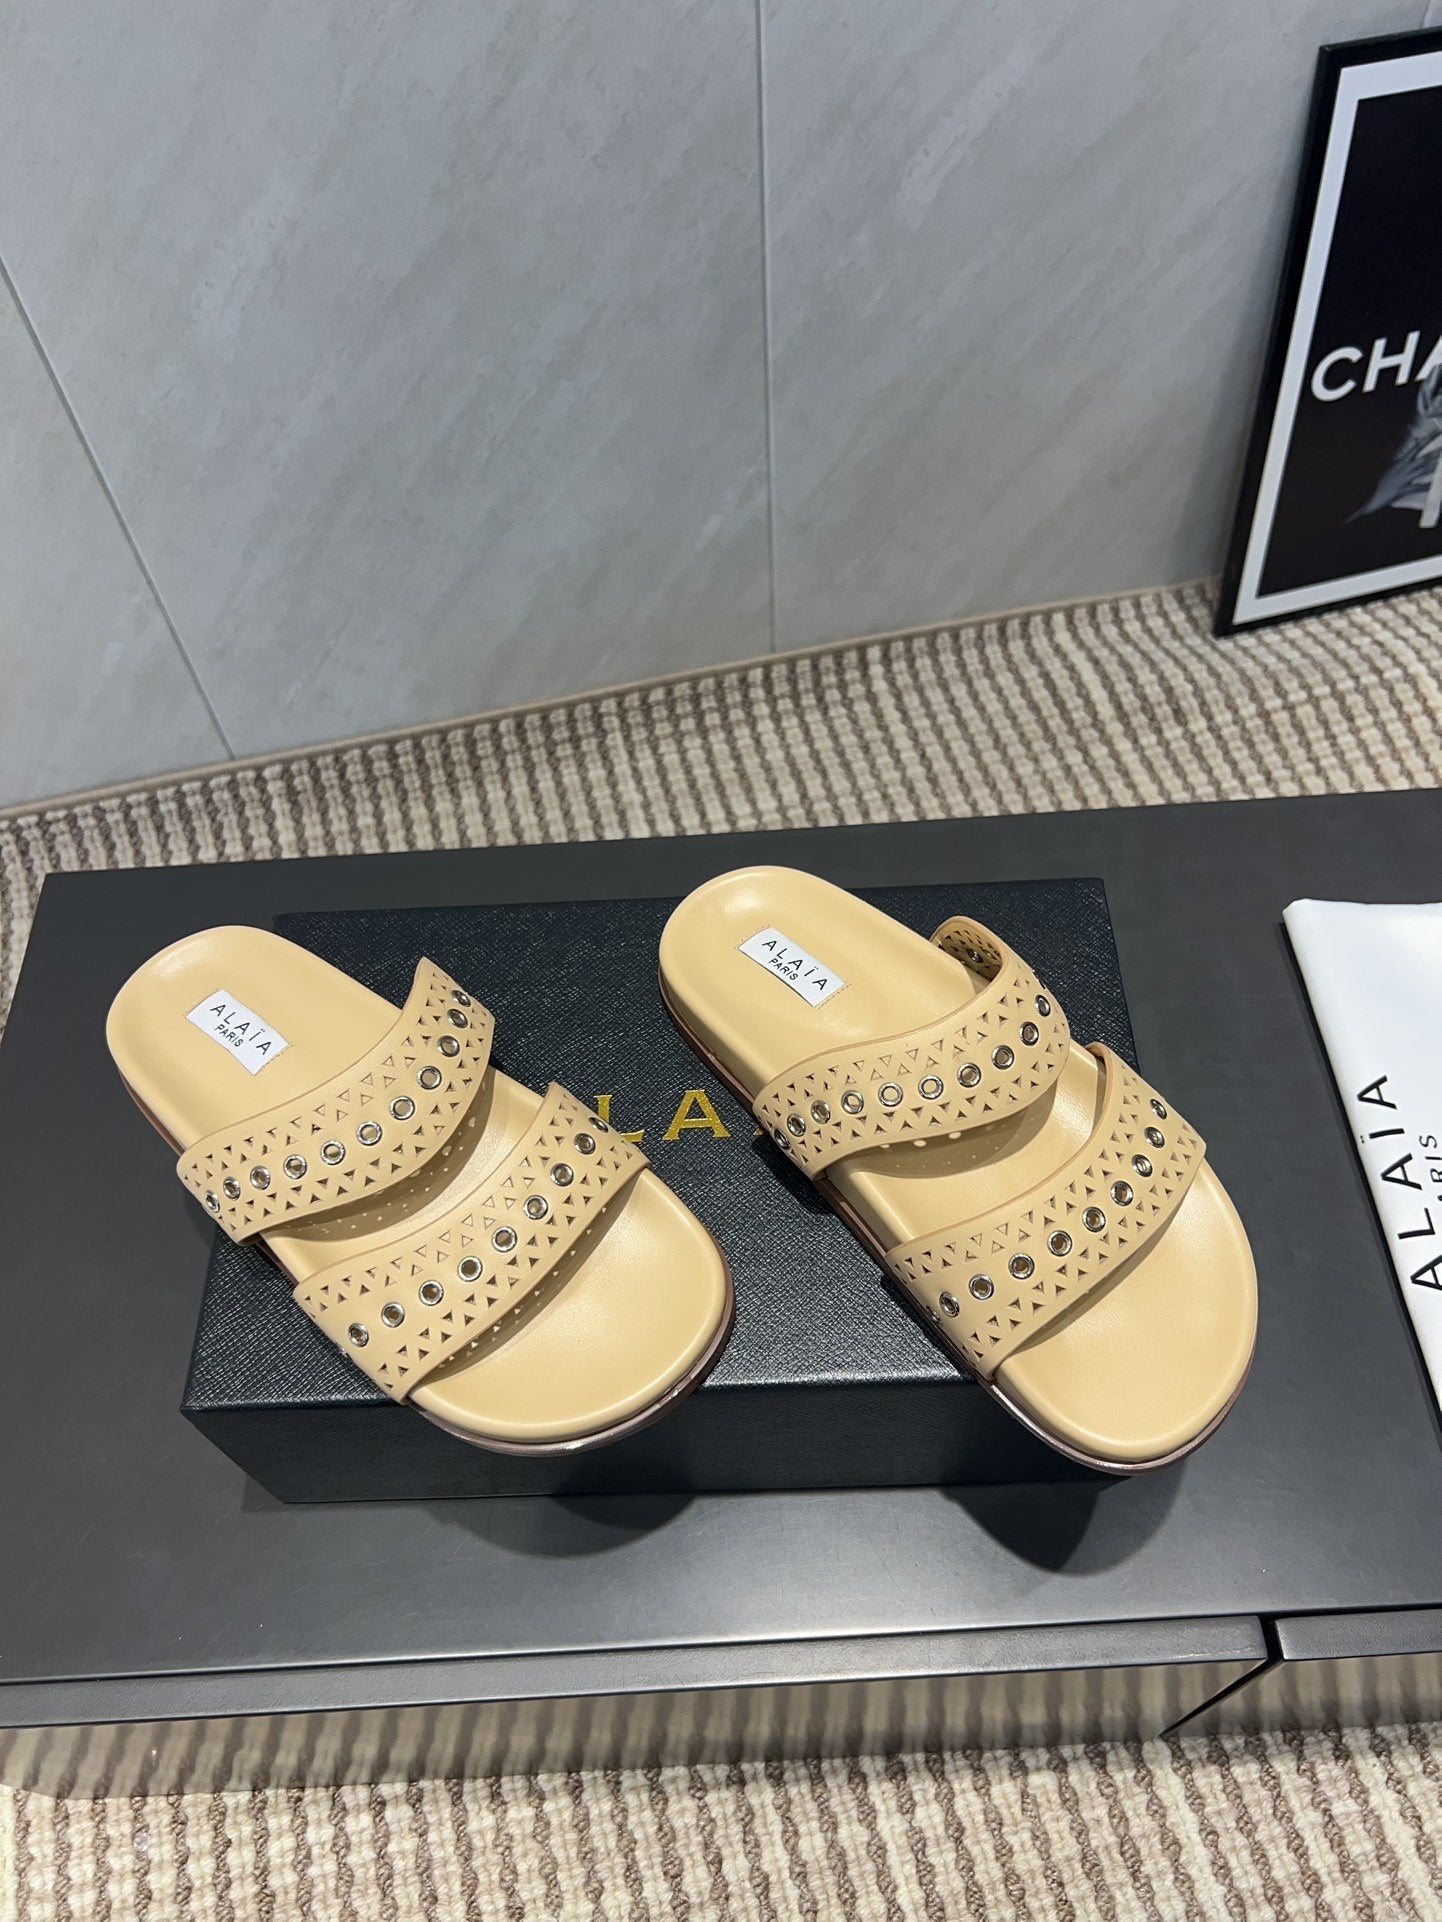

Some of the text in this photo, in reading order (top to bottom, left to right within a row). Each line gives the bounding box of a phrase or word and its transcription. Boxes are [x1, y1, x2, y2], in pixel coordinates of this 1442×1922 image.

[761, 939, 829, 991] ALAÏA
[768, 957, 799, 981] PARIS
[209, 1003, 272, 1056] ALAÏA
[214, 1023, 244, 1047] PARIS
